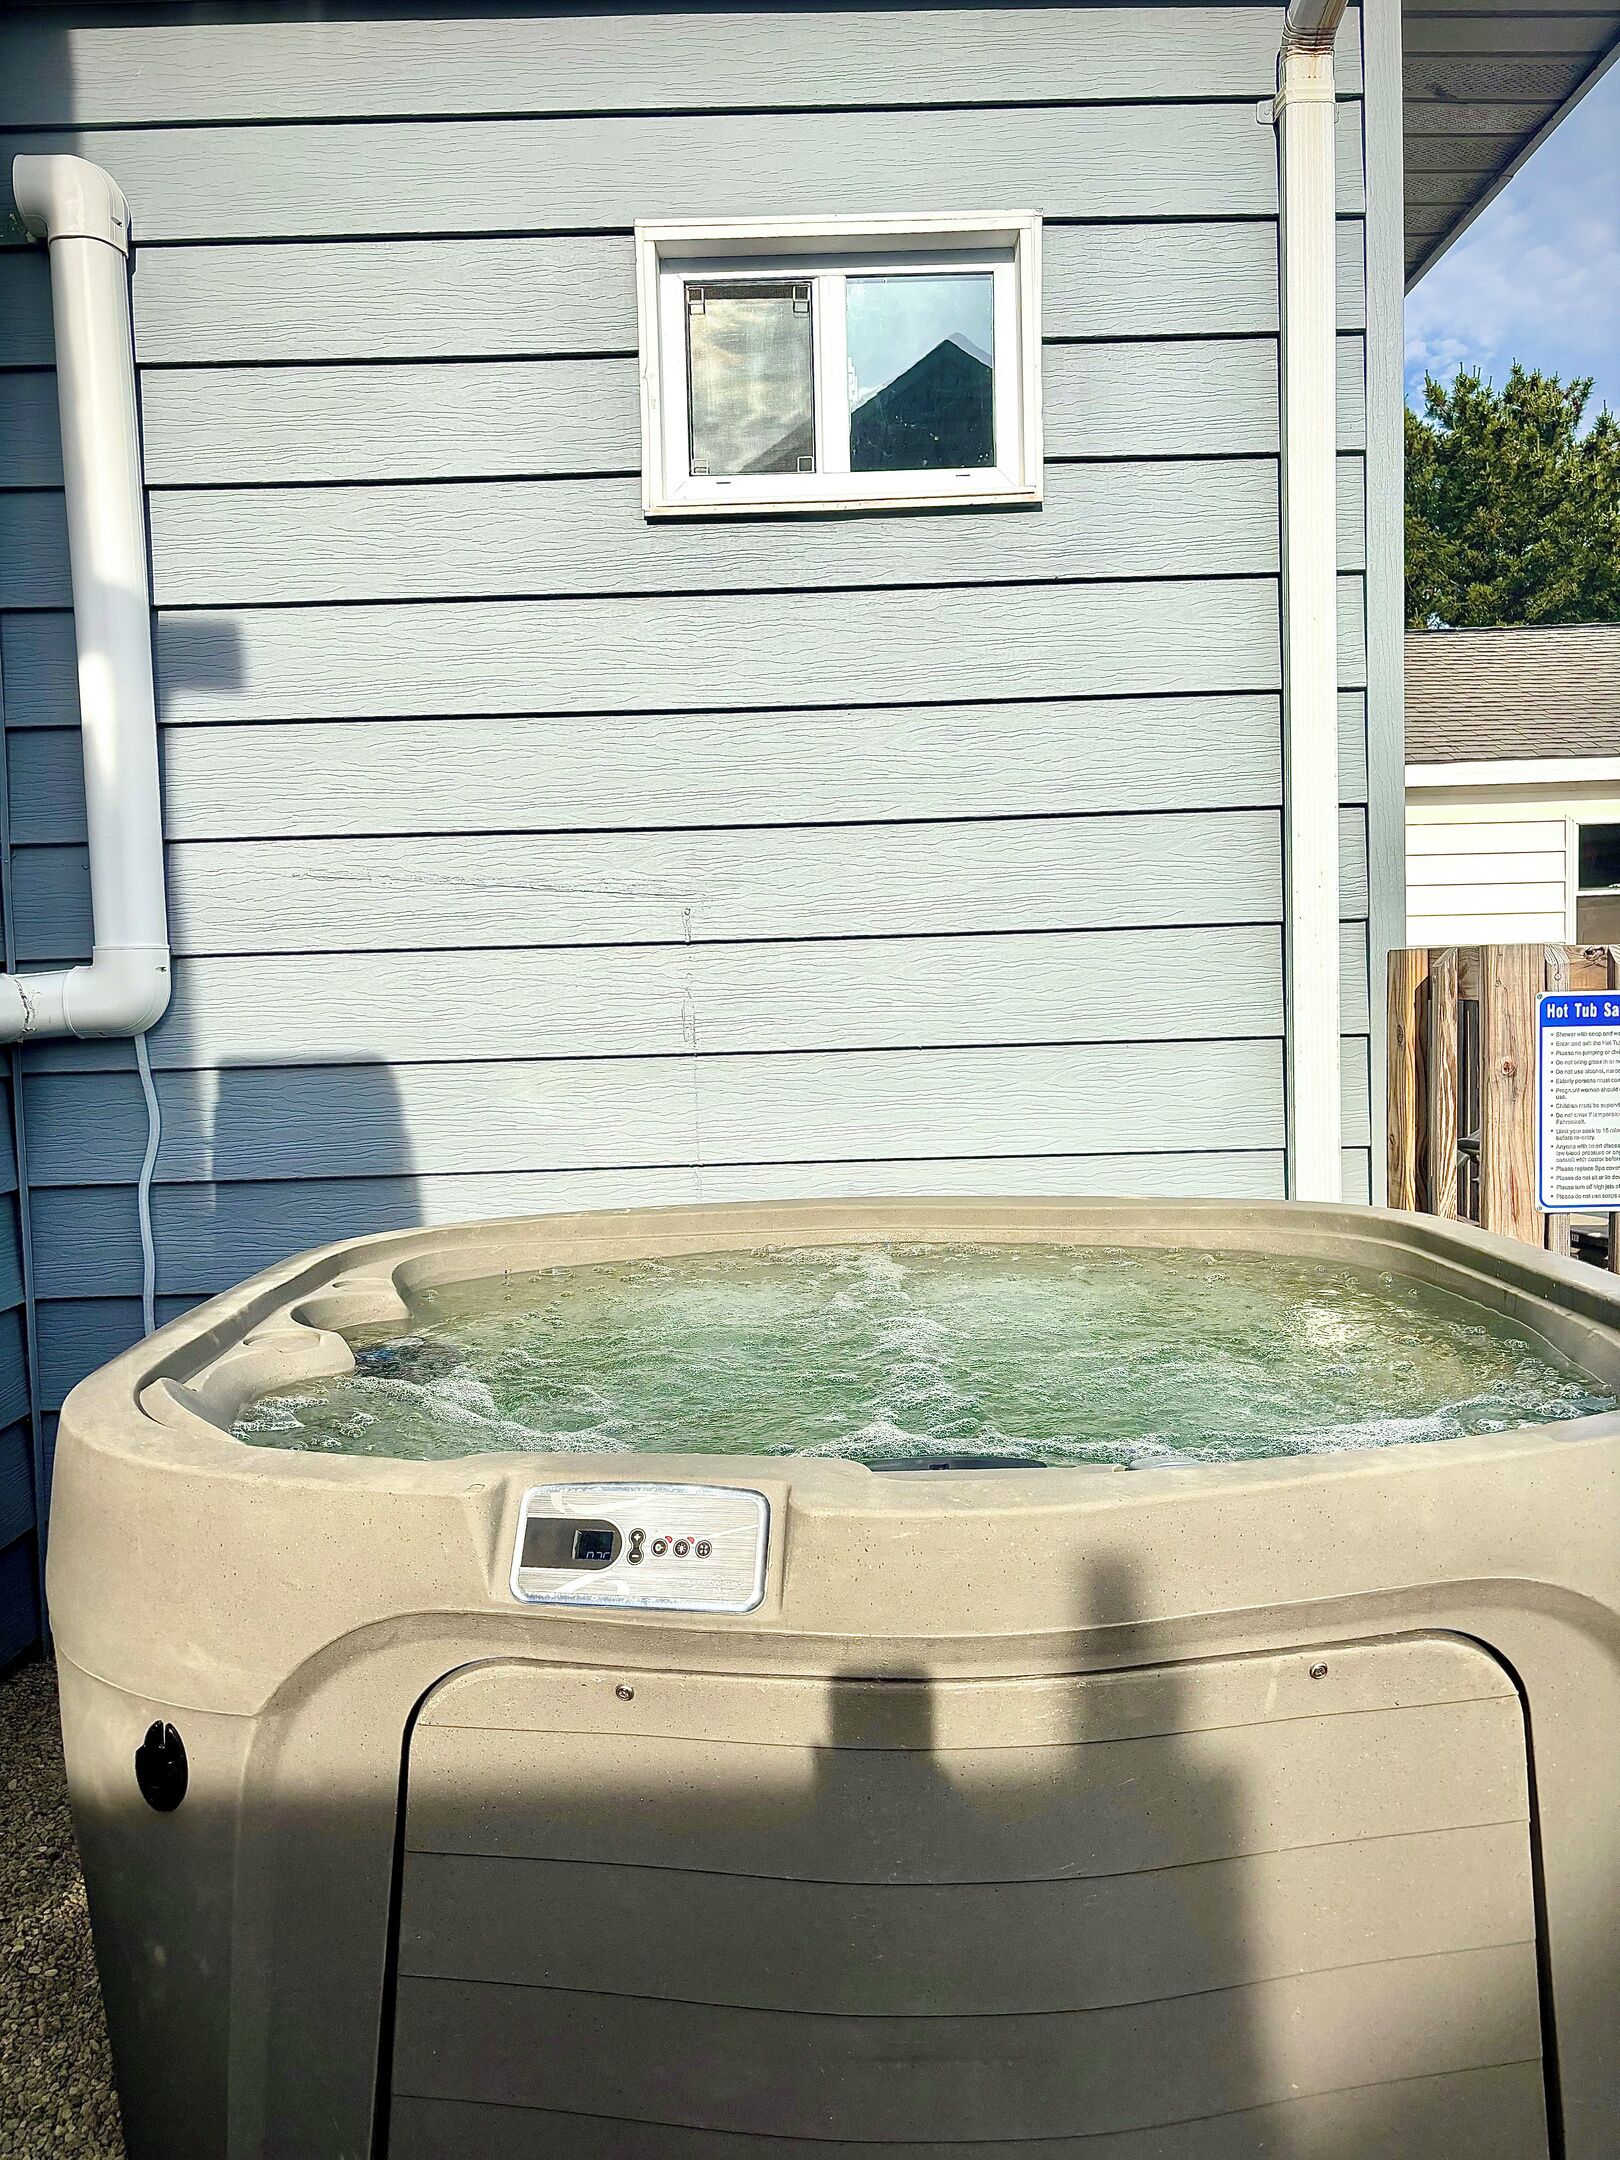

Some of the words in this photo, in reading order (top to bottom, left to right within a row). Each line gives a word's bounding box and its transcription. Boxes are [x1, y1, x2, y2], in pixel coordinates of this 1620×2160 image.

[1546, 1003, 1568, 1018] Hot
[1575, 1002, 1597, 1017] Tub
[1604, 1002, 1620, 1017] Sa
